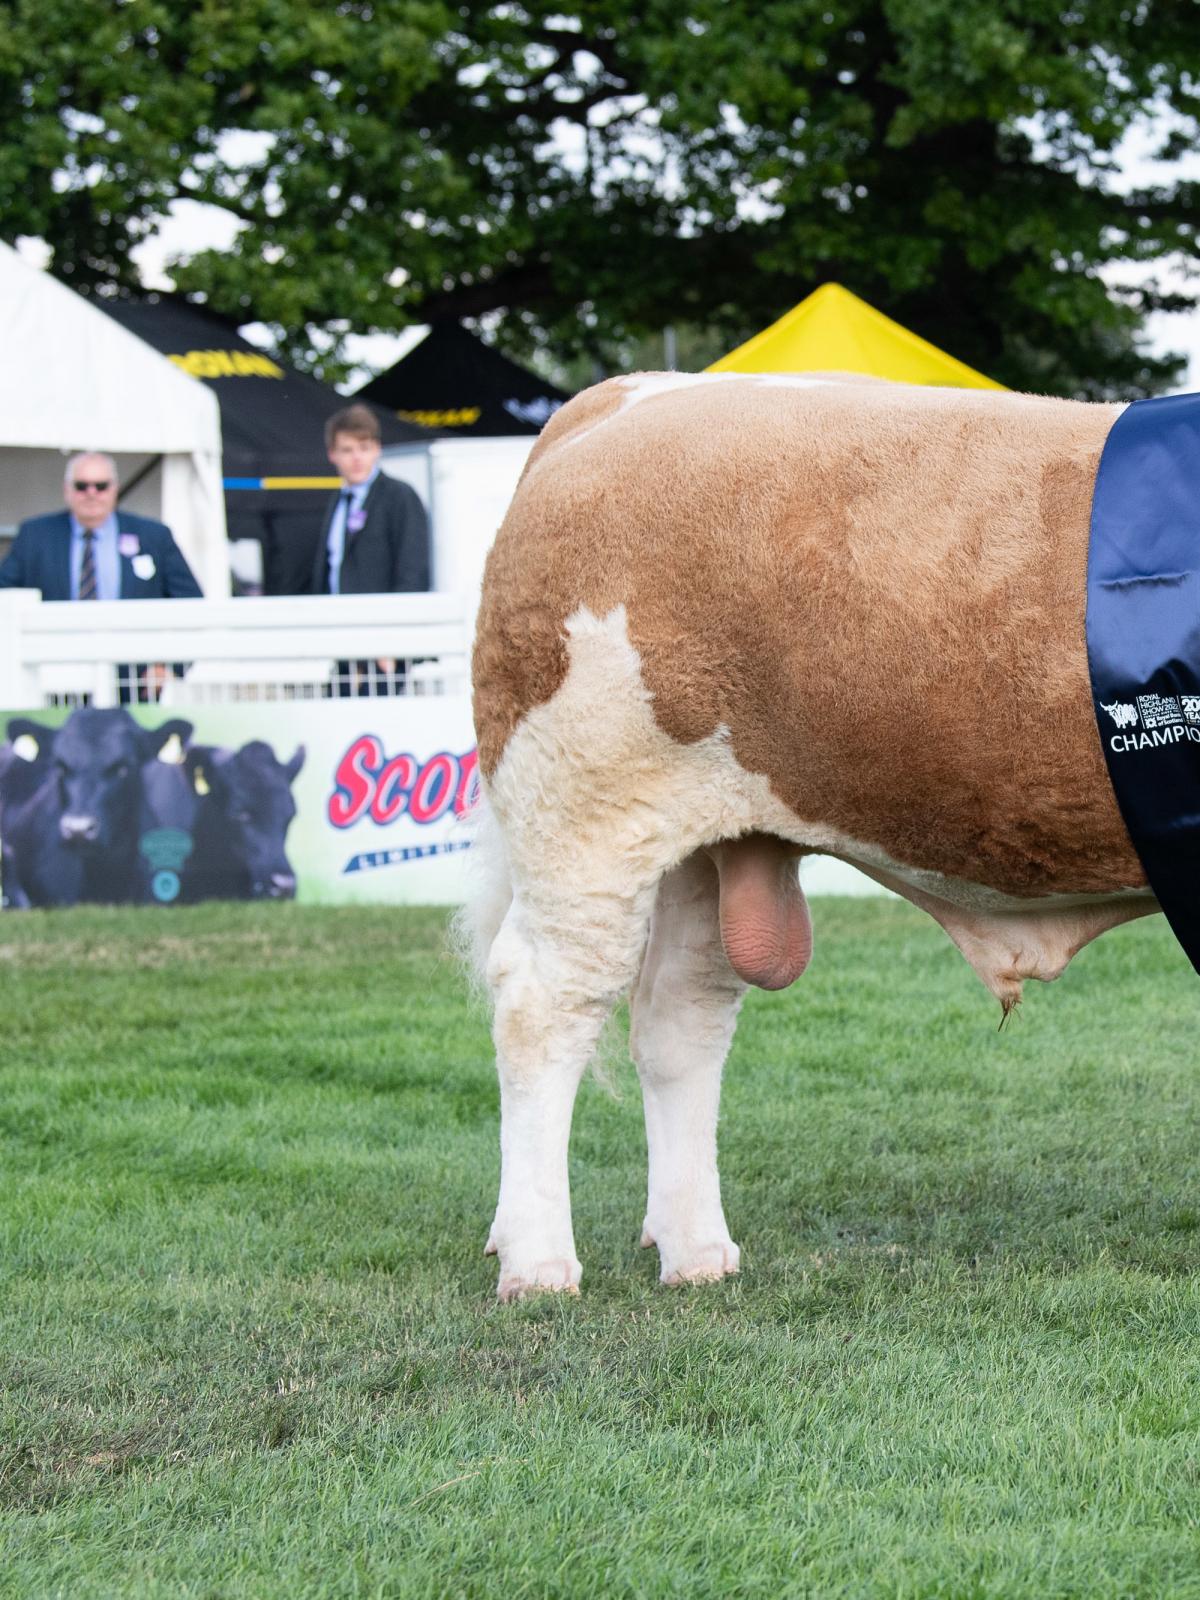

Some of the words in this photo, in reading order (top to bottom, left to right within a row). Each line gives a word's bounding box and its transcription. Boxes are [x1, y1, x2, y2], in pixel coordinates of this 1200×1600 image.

[1139, 694, 1160, 703] ROYAL
[1141, 697, 1176, 709] HIGHLAND
[1142, 705, 1164, 715] SHOW
